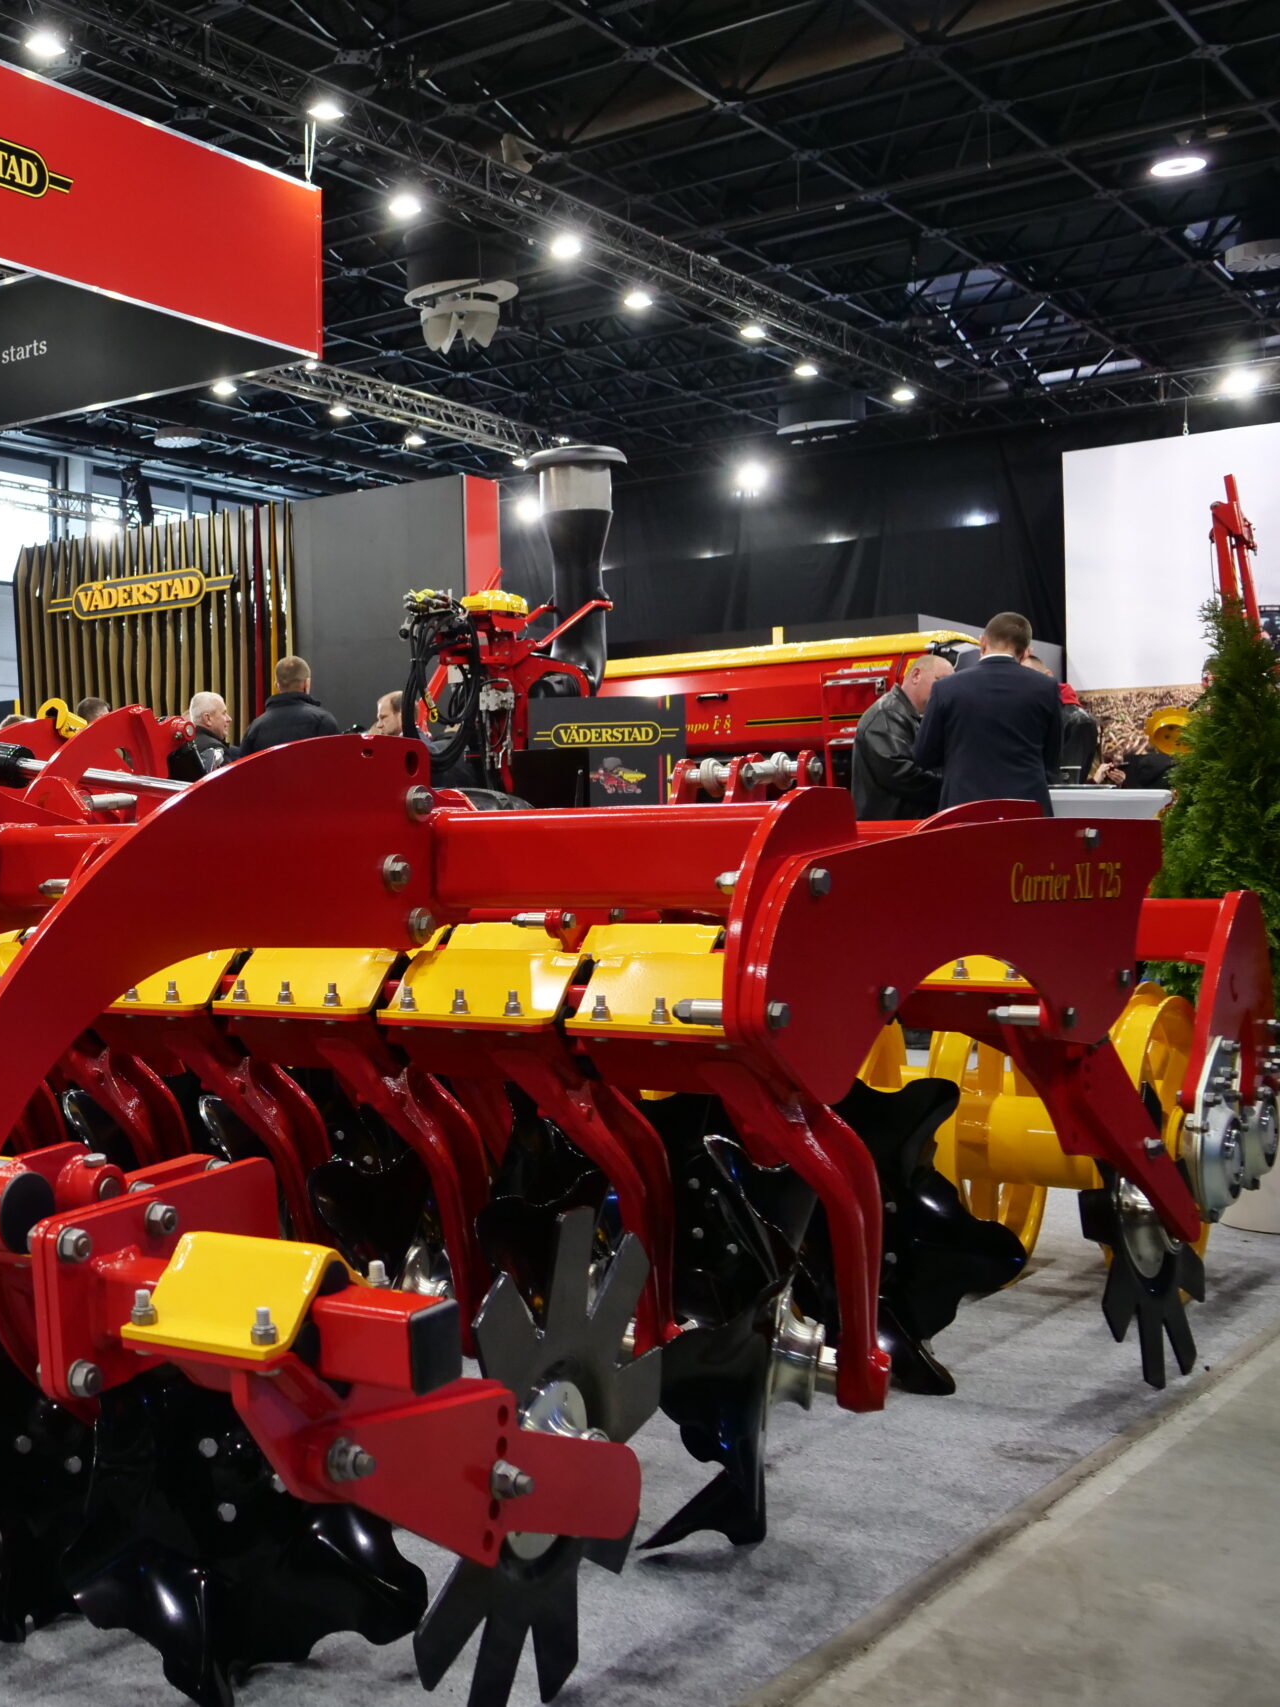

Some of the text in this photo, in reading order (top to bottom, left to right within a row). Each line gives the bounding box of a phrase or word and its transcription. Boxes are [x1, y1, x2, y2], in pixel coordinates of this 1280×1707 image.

[1, 339, 48, 364] starts
[77, 576, 201, 612] VÄDERSTAD
[558, 725, 654, 744] VÄDERSTAD
[685, 722, 710, 735] mpo
[723, 718, 732, 730] 8
[1010, 862, 1122, 904] Carrier XL 725
